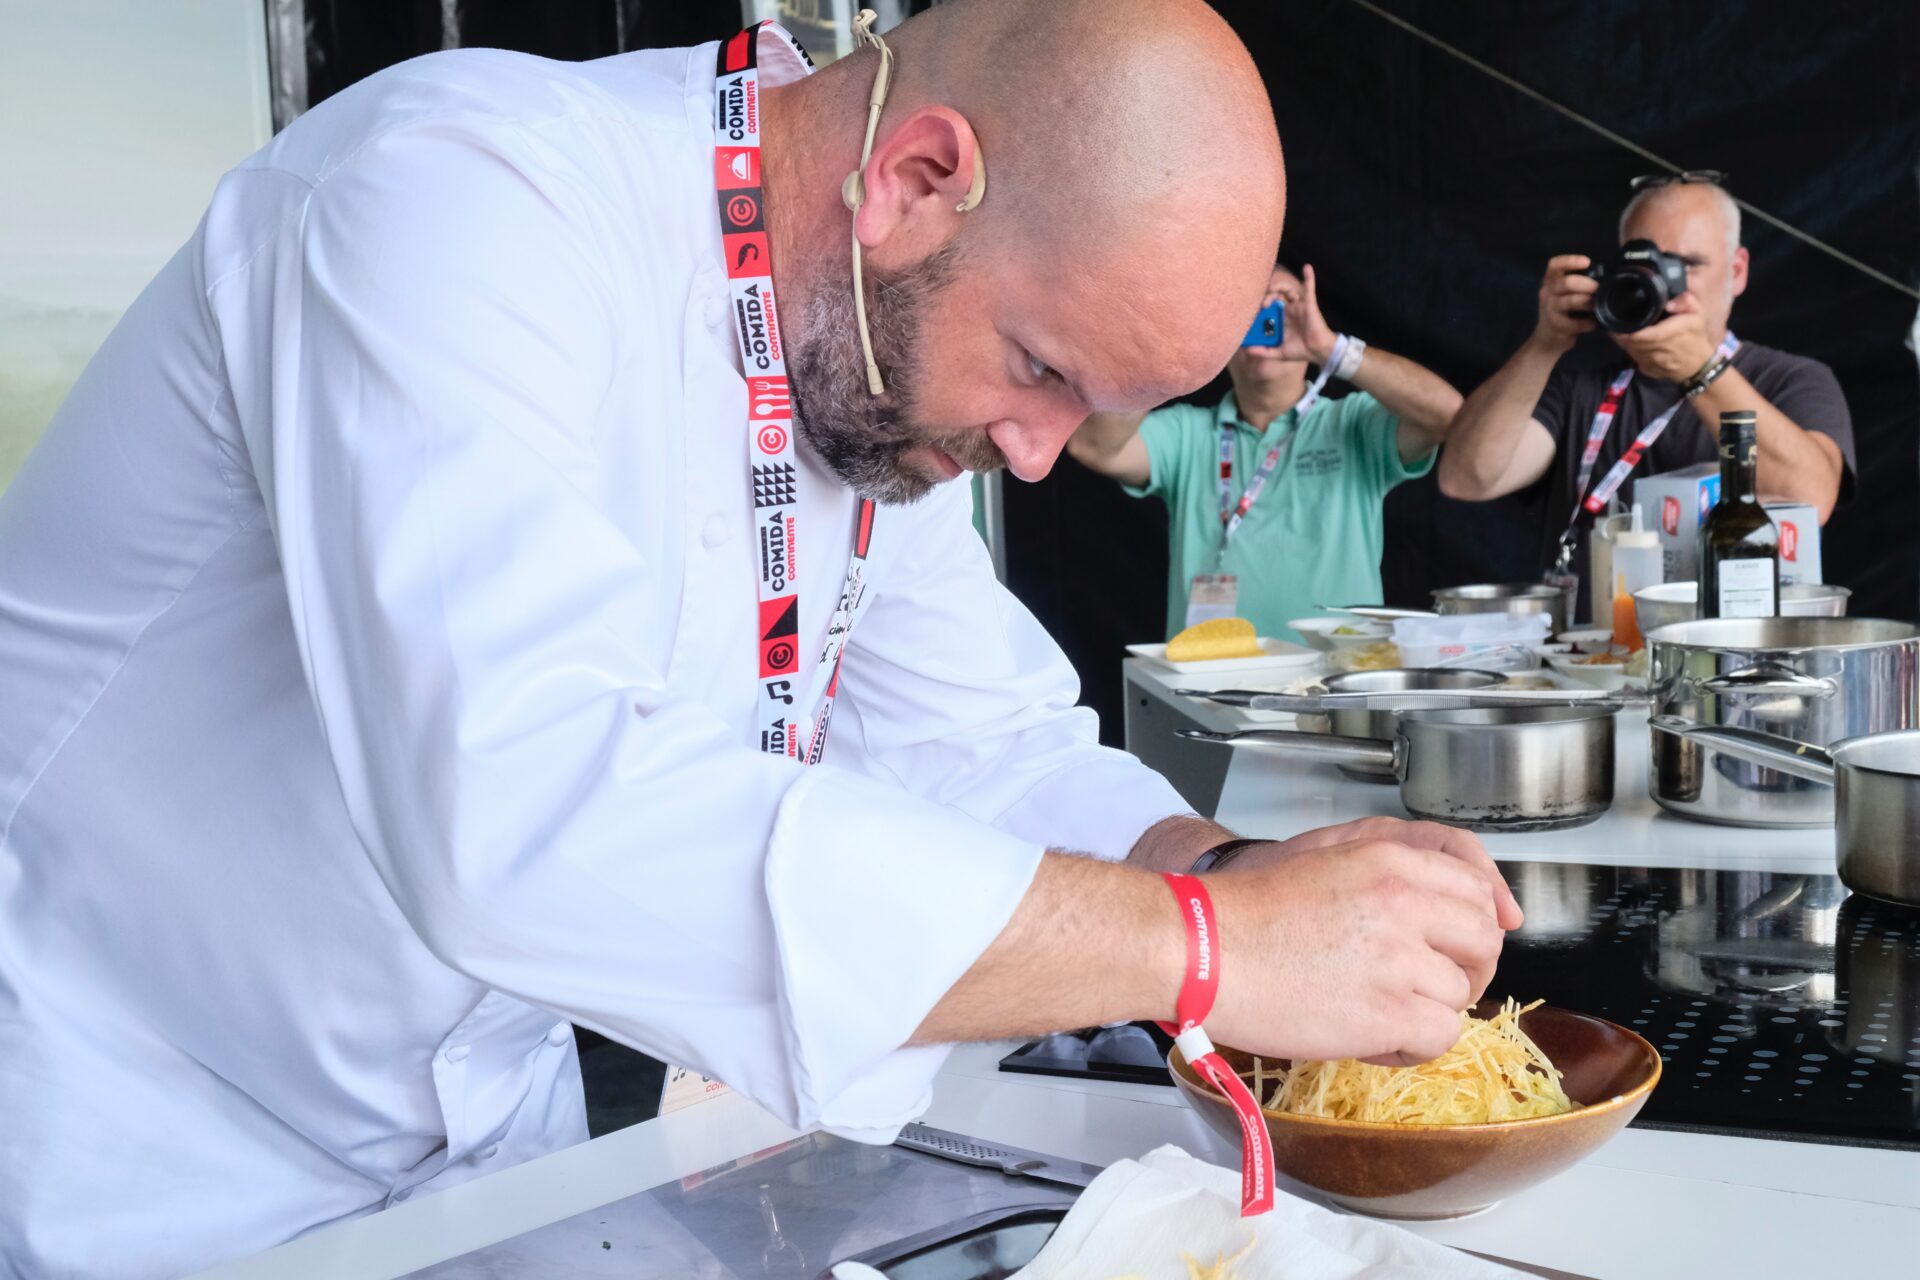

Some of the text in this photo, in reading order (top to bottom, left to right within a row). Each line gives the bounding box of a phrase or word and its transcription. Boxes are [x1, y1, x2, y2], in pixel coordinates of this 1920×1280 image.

[728, 76, 744, 141] COMIDA
[744, 284, 770, 370] COMIDA
[768, 510, 785, 592] COMIDA
[770, 717, 785, 754] IDA
[788, 723, 797, 757] INENTE
[809, 703, 829, 765] COMID
[1190, 897, 1211, 981] CONTINENTE
